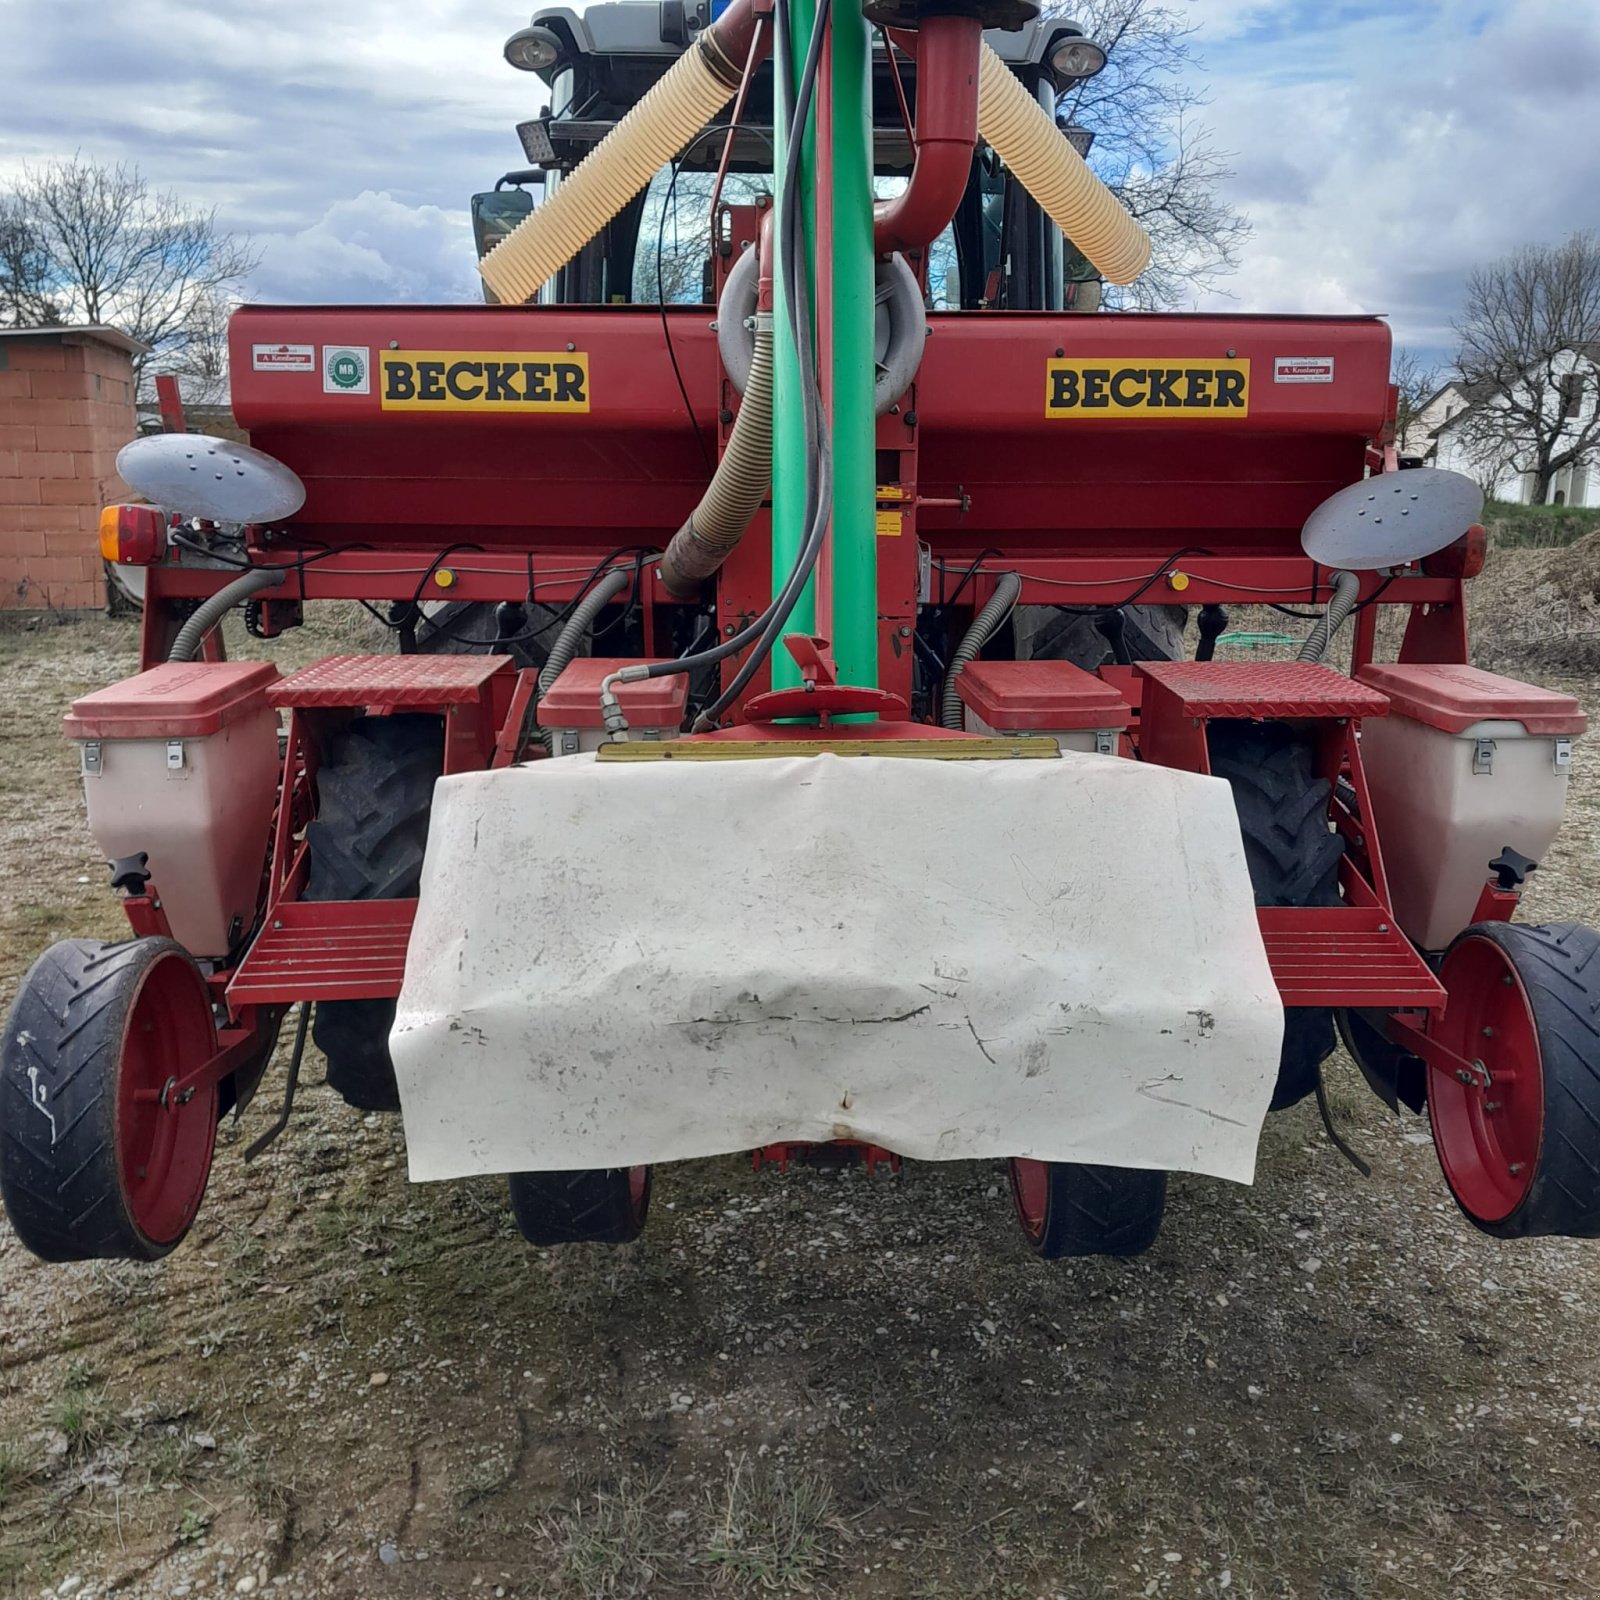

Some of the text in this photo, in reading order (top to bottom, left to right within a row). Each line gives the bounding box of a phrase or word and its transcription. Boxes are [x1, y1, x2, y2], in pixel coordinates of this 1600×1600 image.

[338, 364, 354, 376] MR
[384, 361, 586, 404] BECKER
[1050, 368, 1246, 408] BECKER
